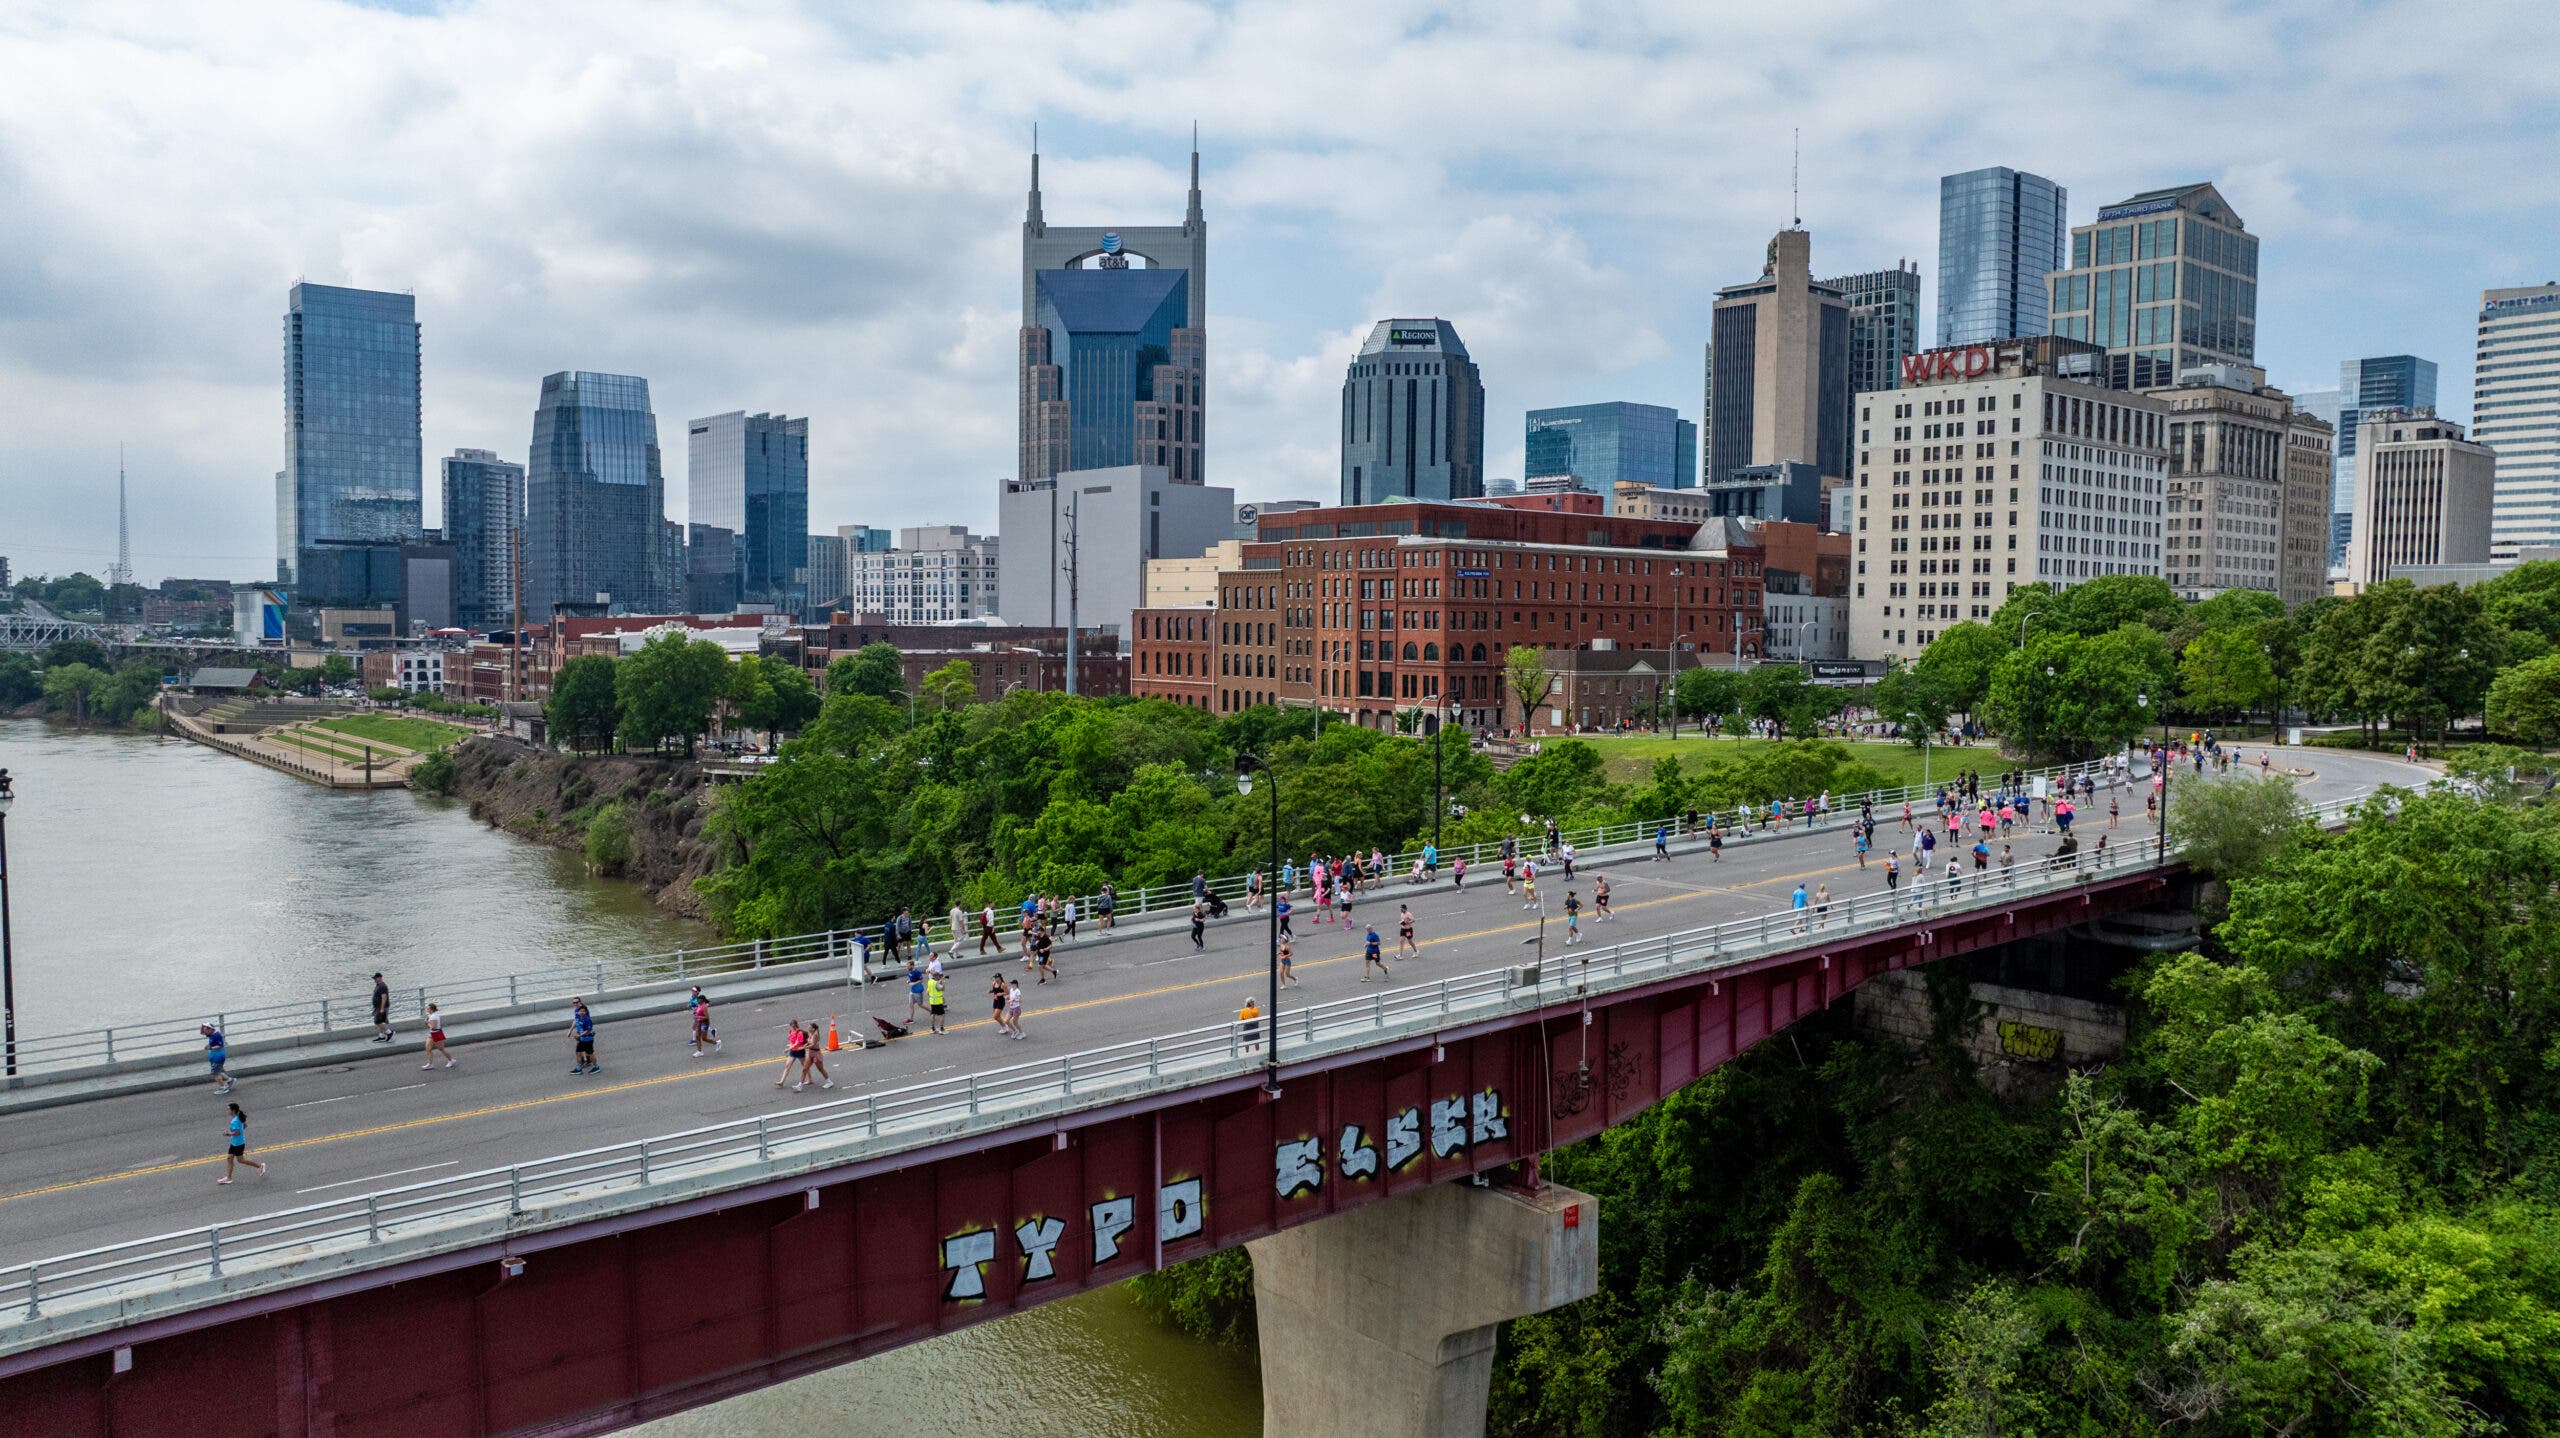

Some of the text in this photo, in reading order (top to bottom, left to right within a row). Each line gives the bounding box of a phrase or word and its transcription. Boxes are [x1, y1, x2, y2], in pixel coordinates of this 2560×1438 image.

[2151, 202, 2173, 210] BANK
[2499, 299, 2528, 307] FIRST
[943, 1176, 1203, 1300] TYPO
